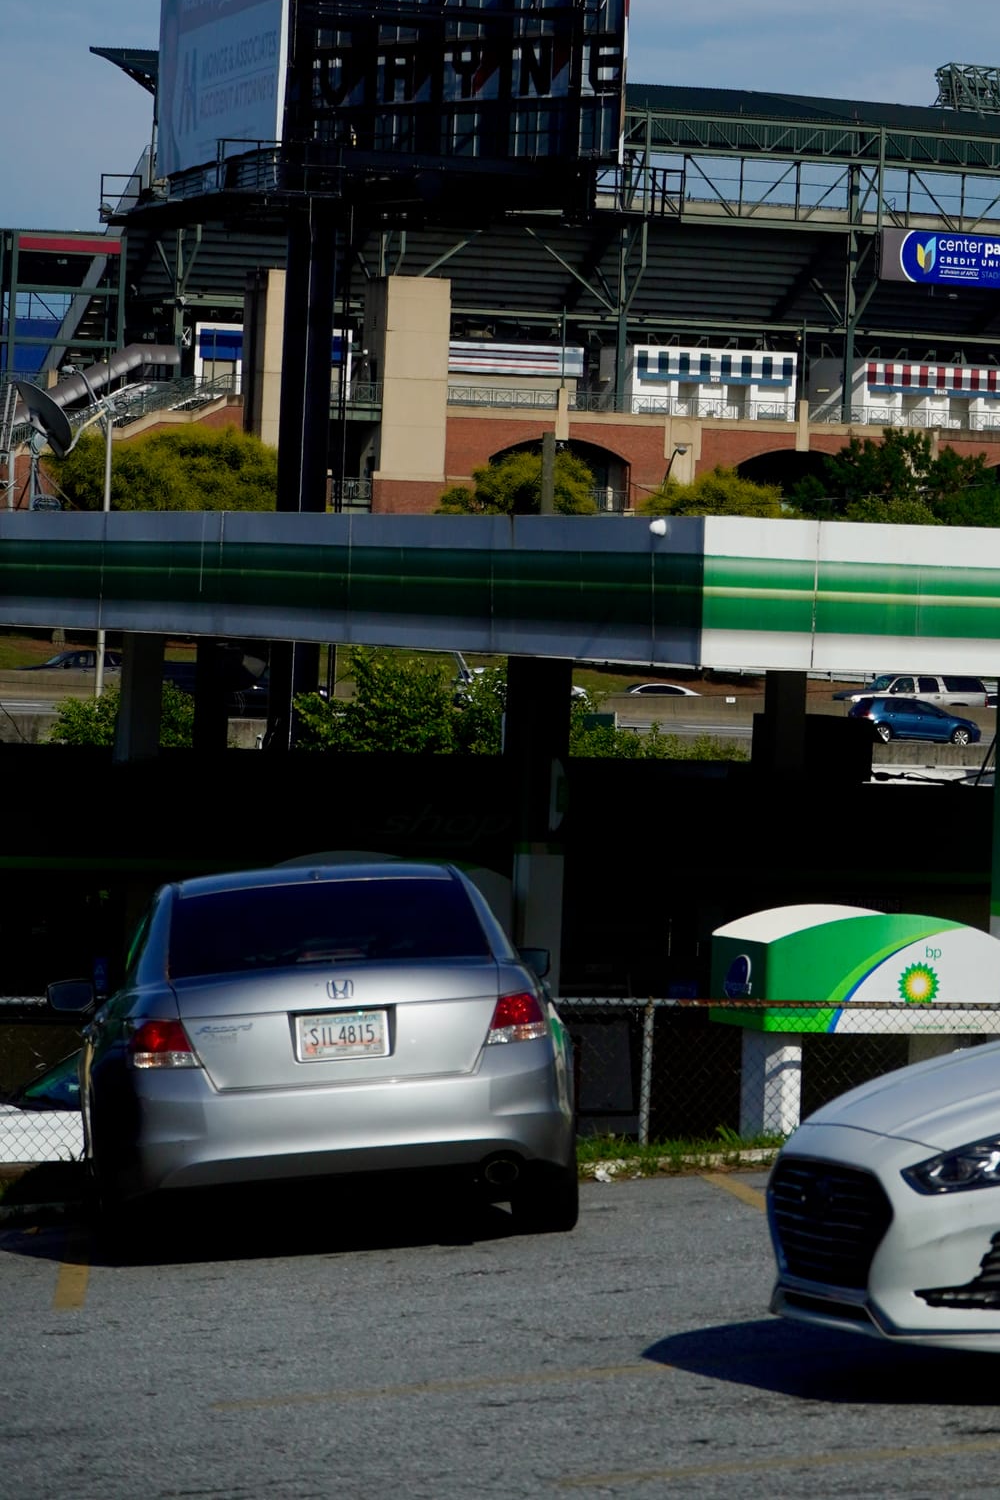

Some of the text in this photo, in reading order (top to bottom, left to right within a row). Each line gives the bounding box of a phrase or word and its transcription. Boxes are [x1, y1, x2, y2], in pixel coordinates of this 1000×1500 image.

[235, 27, 277, 68] ASSOCIATES
[199, 71, 274, 123] ACCIDENT ATTORNEYS
[938, 239, 983, 253] center
[939, 256, 976, 266] CREDIT
[385, 804, 512, 847] shop
[925, 945, 942, 961] bp
[310, 1024, 376, 1047] SIL4815
